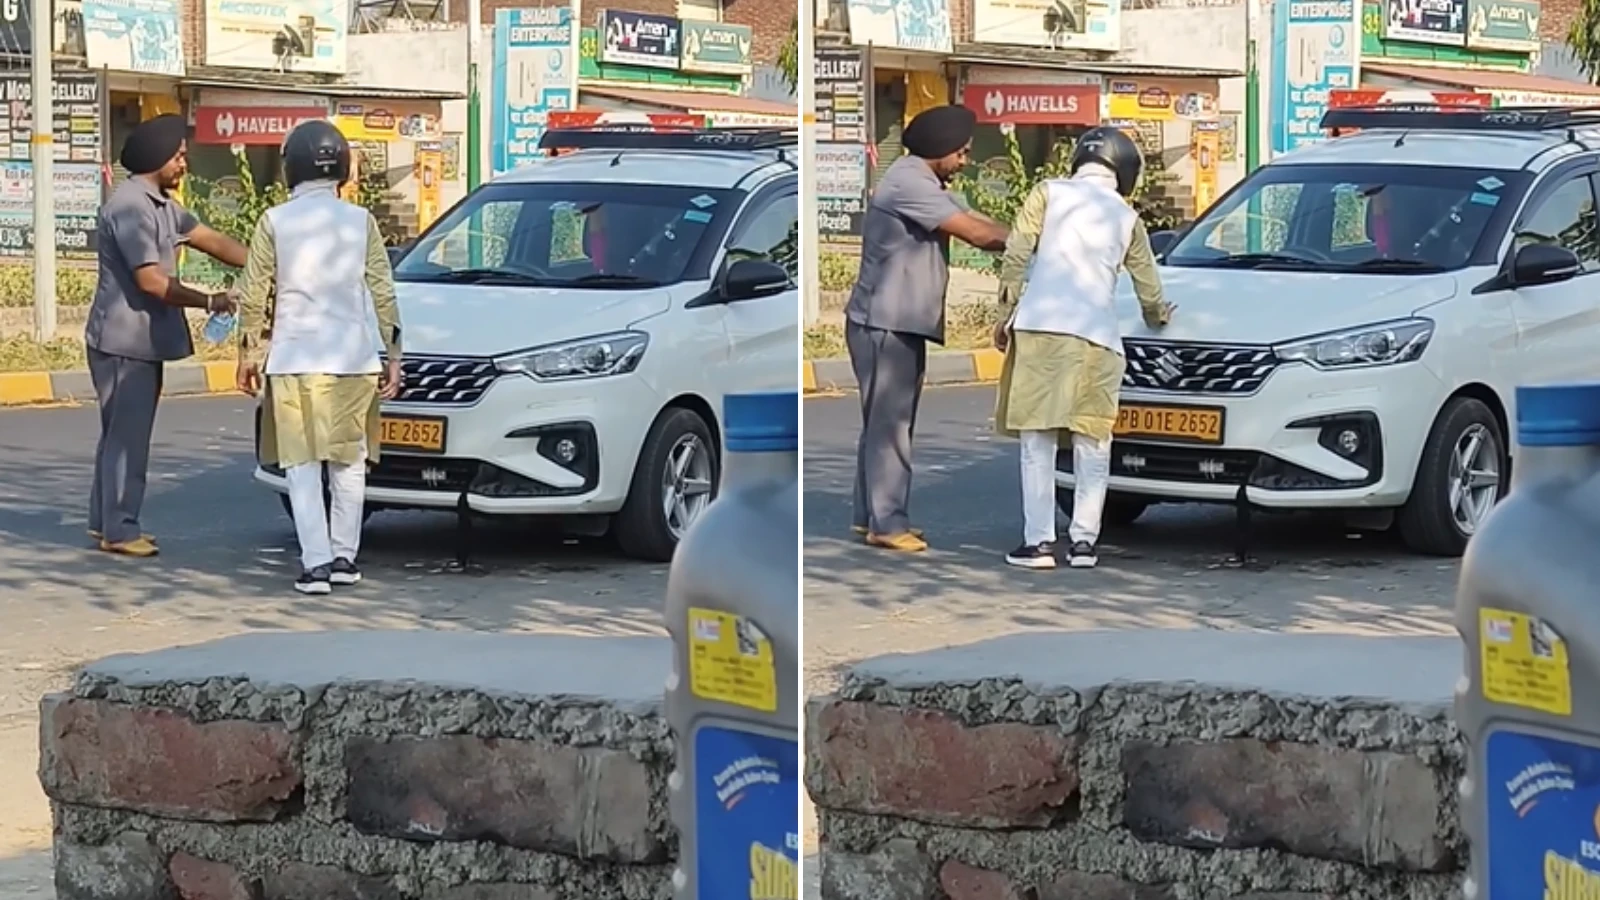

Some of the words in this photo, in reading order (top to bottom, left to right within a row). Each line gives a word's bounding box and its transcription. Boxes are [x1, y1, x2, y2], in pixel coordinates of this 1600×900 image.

[1489, 3, 1525, 21] Aman
[636, 19, 668, 36] Aman
[702, 28, 736, 44] Aman
[1007, 95, 1078, 113] HAVELLS
[238, 117, 301, 134] HAVELL
[1120, 409, 1140, 429] PB
[1144, 411, 1174, 431] 01E
[1179, 413, 1219, 434] 2652
[381, 421, 398, 441] 1E
[402, 423, 440, 444] 2652
